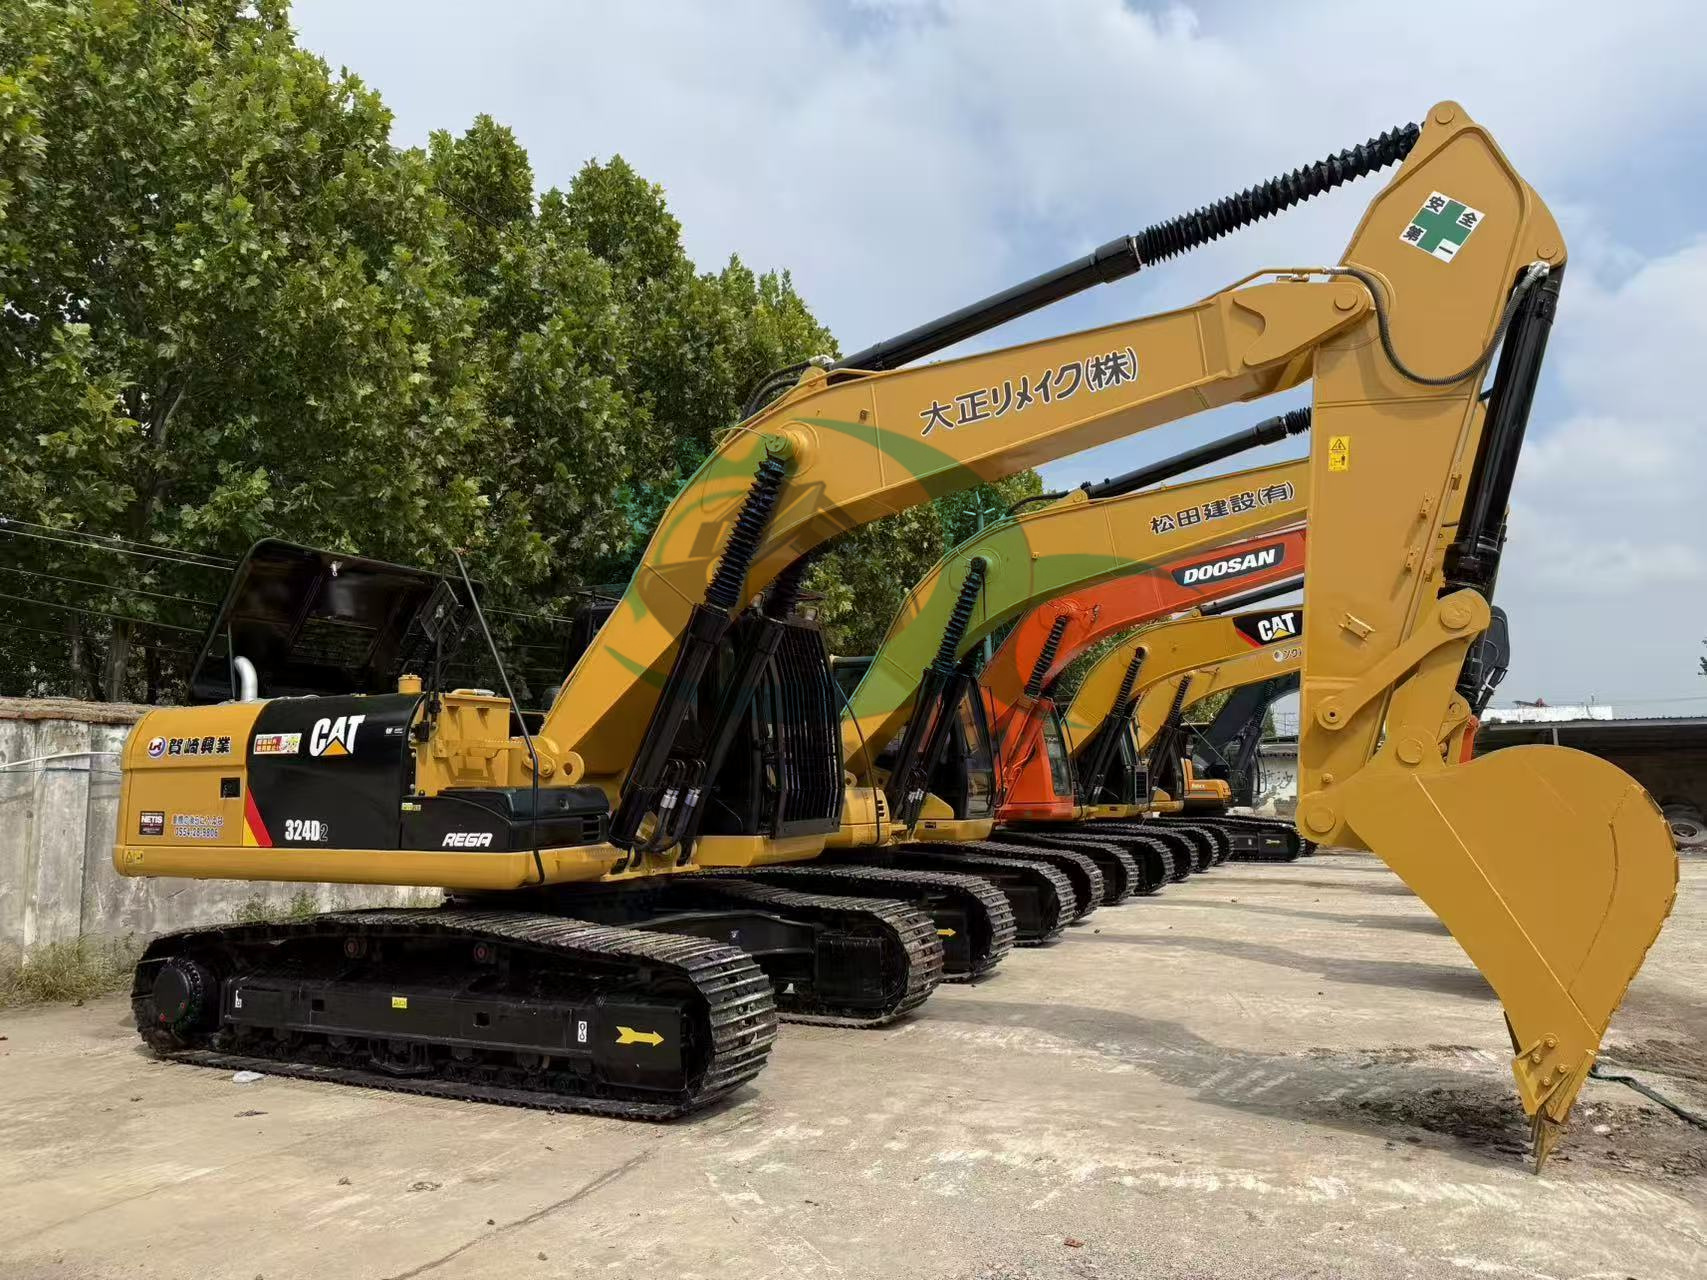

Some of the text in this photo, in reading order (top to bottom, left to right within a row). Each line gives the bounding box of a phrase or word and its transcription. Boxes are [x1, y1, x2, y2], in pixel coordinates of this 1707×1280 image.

[919, 346, 1138, 436] 大正リメイク(株)
[1149, 481, 1295, 535] 松田建設(有)
[1183, 549, 1276, 584] DOOSAN
[1257, 612, 1297, 641] CAT
[309, 714, 366, 757] CAT
[141, 815, 163, 824] NETIS
[284, 819, 329, 842] 324D2
[441, 832, 494, 848] REGA
